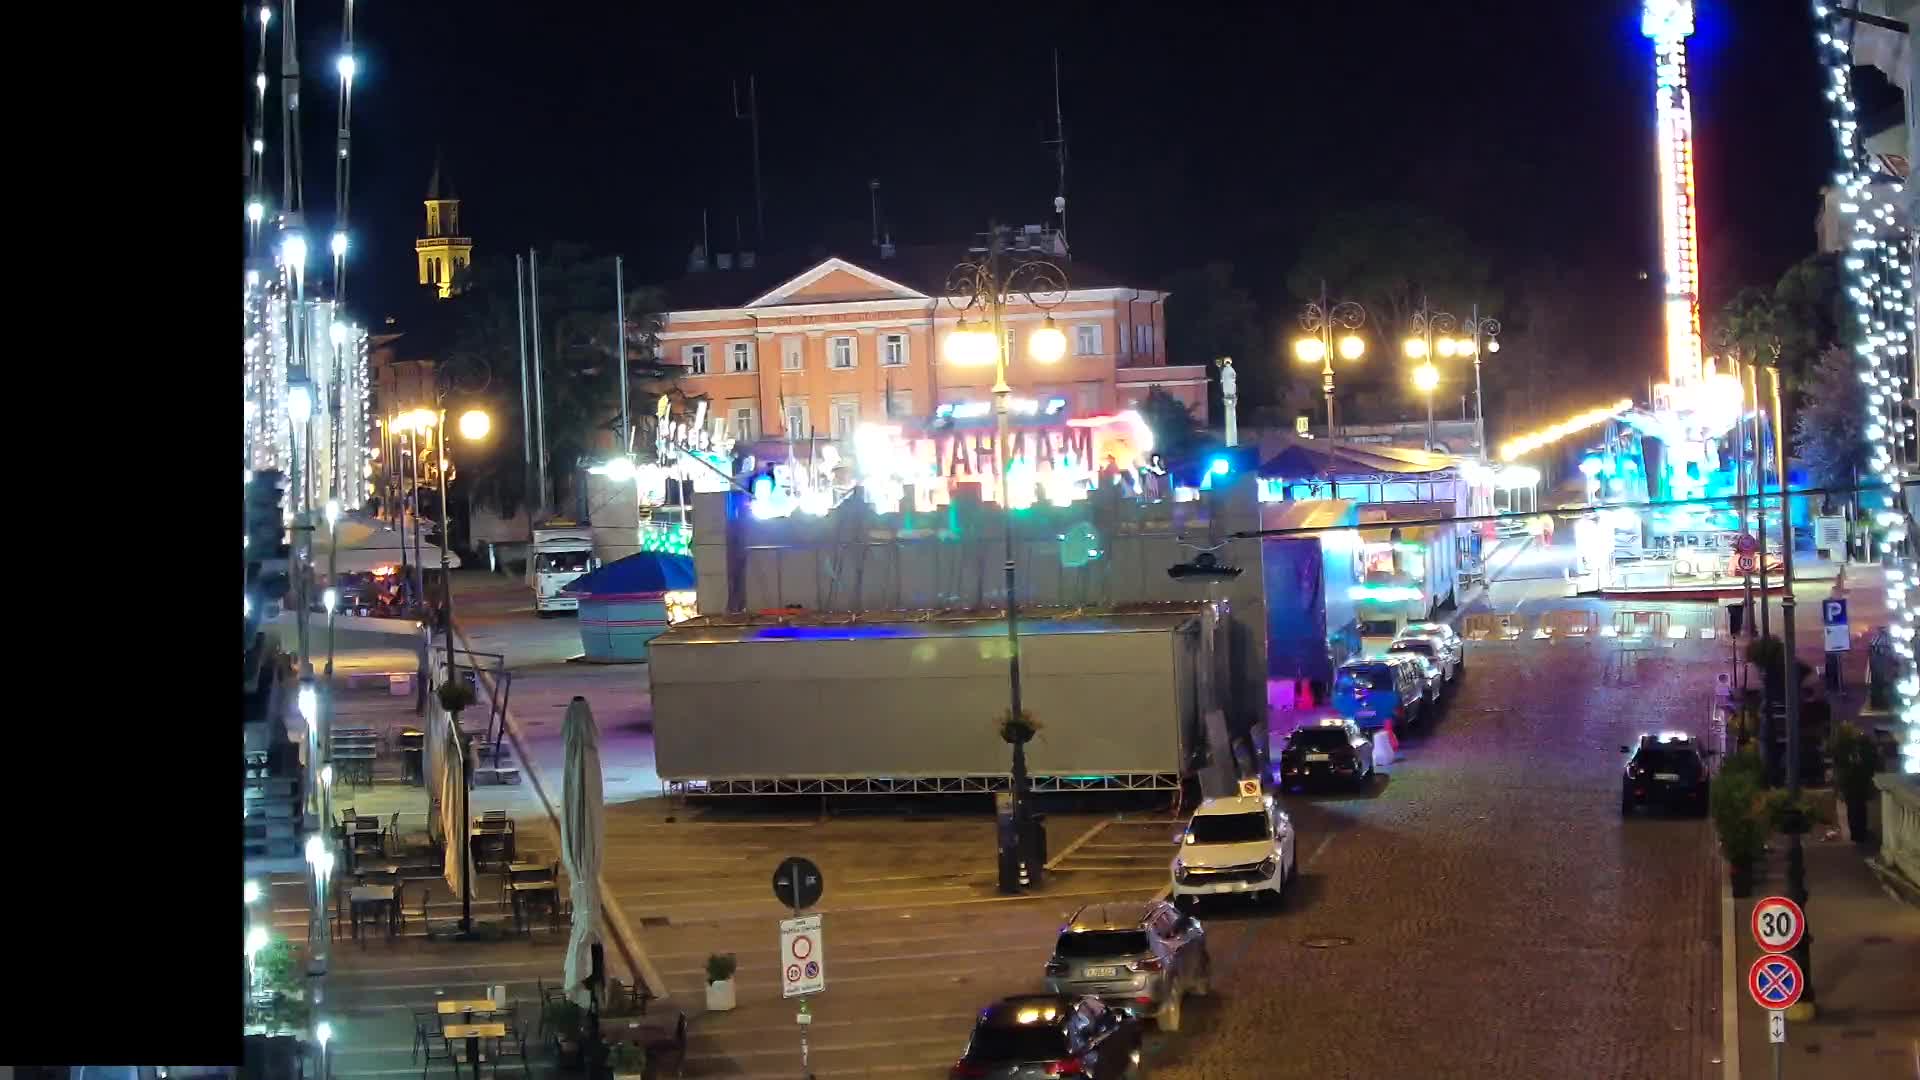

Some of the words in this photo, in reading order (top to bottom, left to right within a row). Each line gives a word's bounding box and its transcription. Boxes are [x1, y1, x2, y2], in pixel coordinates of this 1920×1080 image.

[1743, 558, 1752, 567] 20
[1826, 602, 1842, 622] P
[1762, 912, 1791, 937] 30
